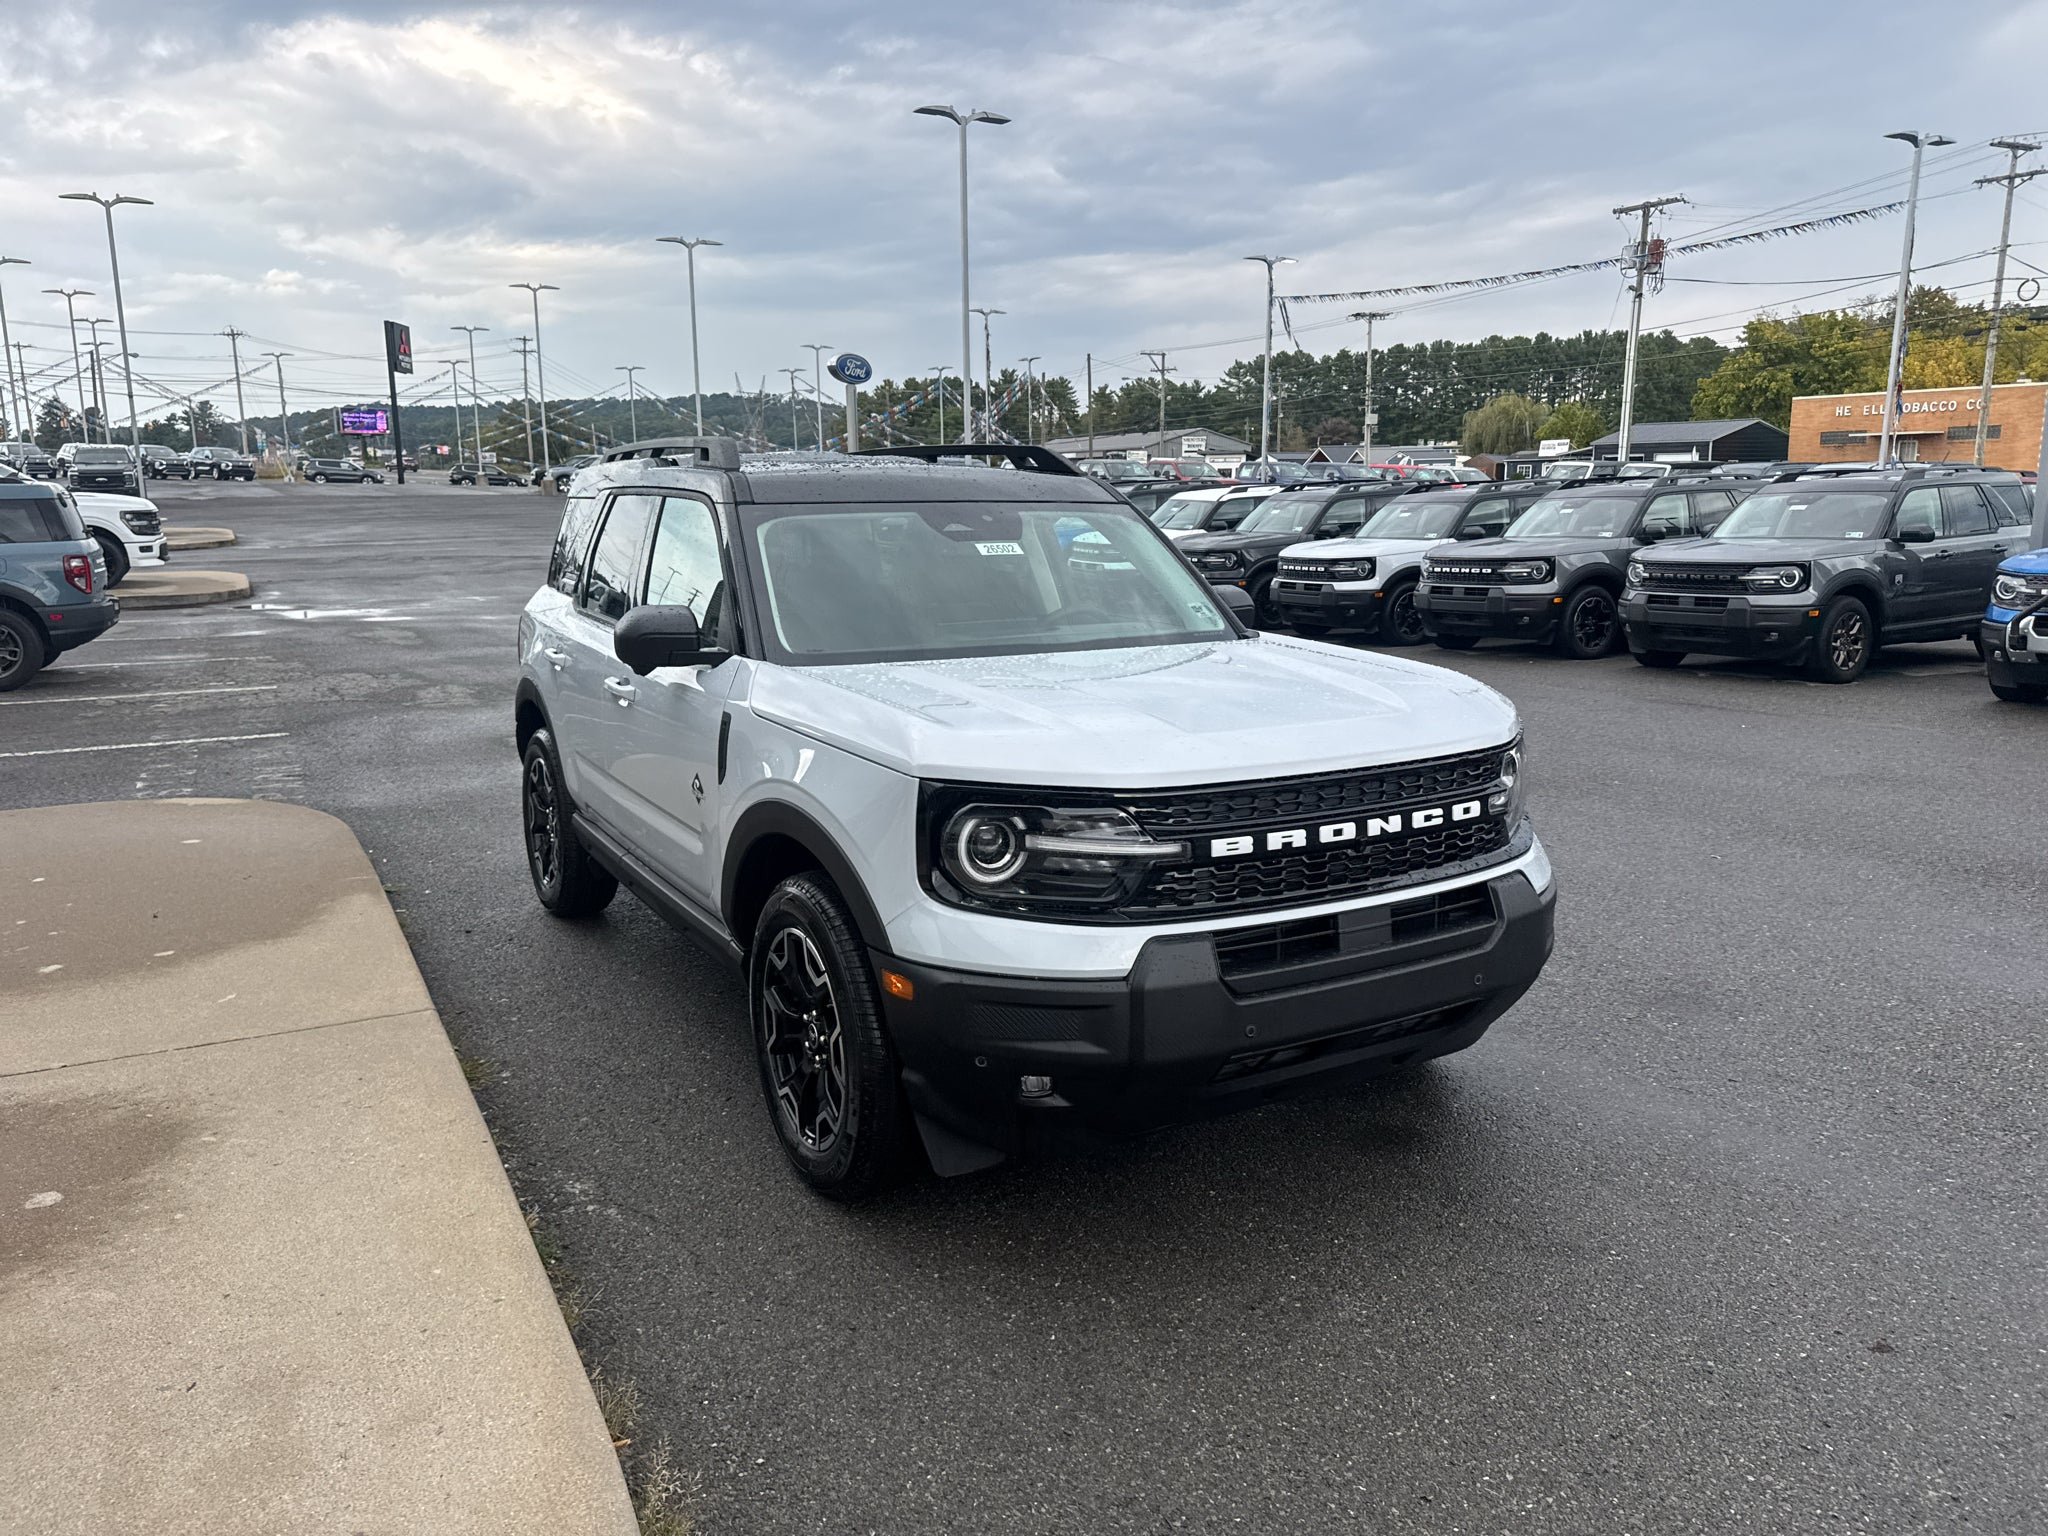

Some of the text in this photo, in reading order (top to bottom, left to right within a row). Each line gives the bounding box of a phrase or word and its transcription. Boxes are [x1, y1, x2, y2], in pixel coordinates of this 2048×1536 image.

[844, 358, 867, 378] Ford
[1895, 400, 1958, 413] OBACCO
[983, 544, 1017, 554] 26502
[1282, 564, 1325, 572] BRONCO
[1211, 800, 1481, 858] BRONCO
